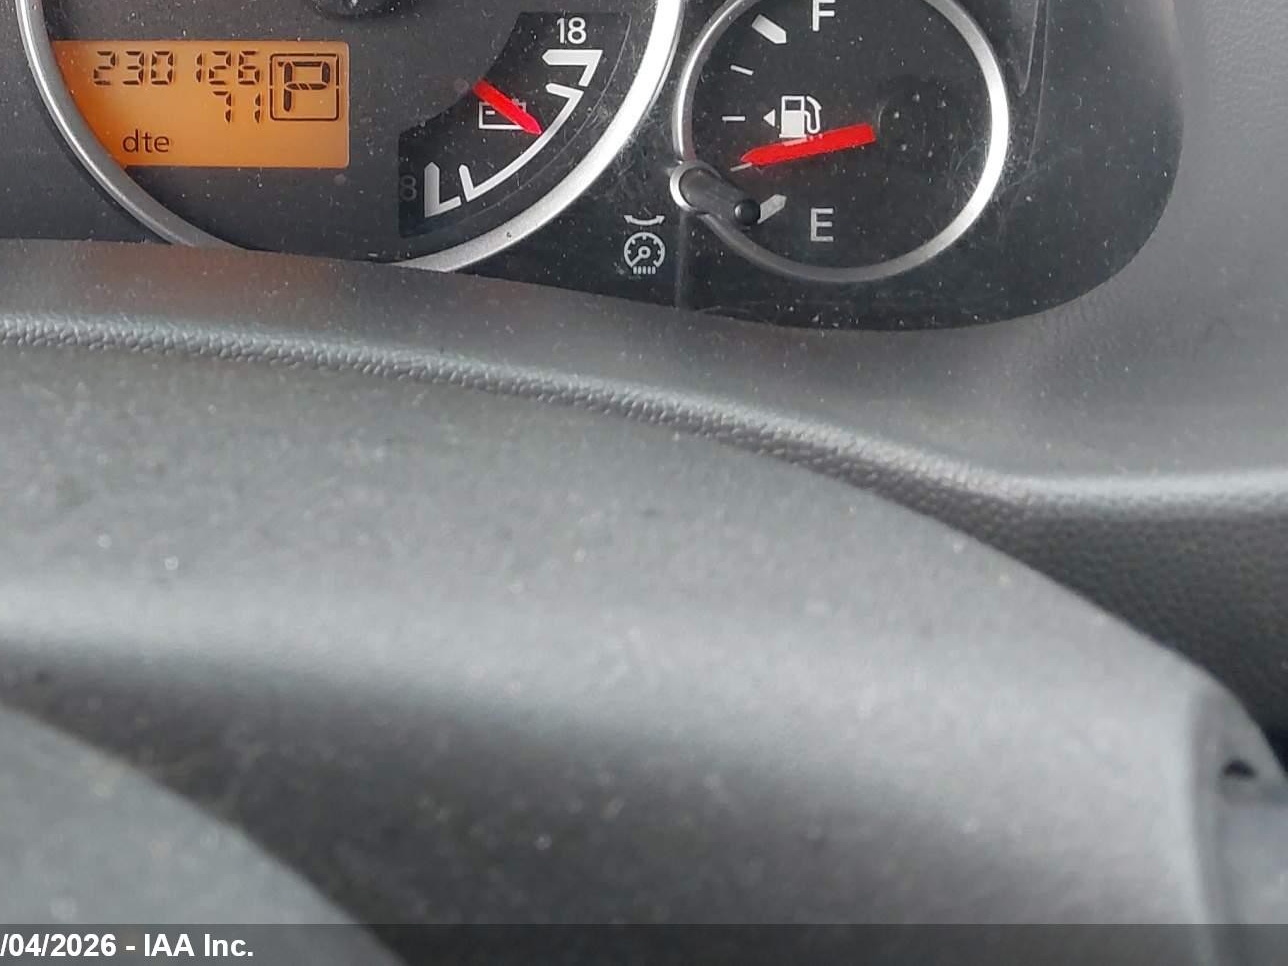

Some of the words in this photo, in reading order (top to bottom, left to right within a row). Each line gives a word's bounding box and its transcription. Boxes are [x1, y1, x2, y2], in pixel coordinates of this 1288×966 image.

[556, 17, 587, 44] 18
[93, 50, 261, 85] 230126
[278, 60, 331, 113] P
[212, 90, 261, 124] 71
[122, 128, 170, 154] dte
[400, 174, 417, 201] 8
[810, 208, 834, 242] E
